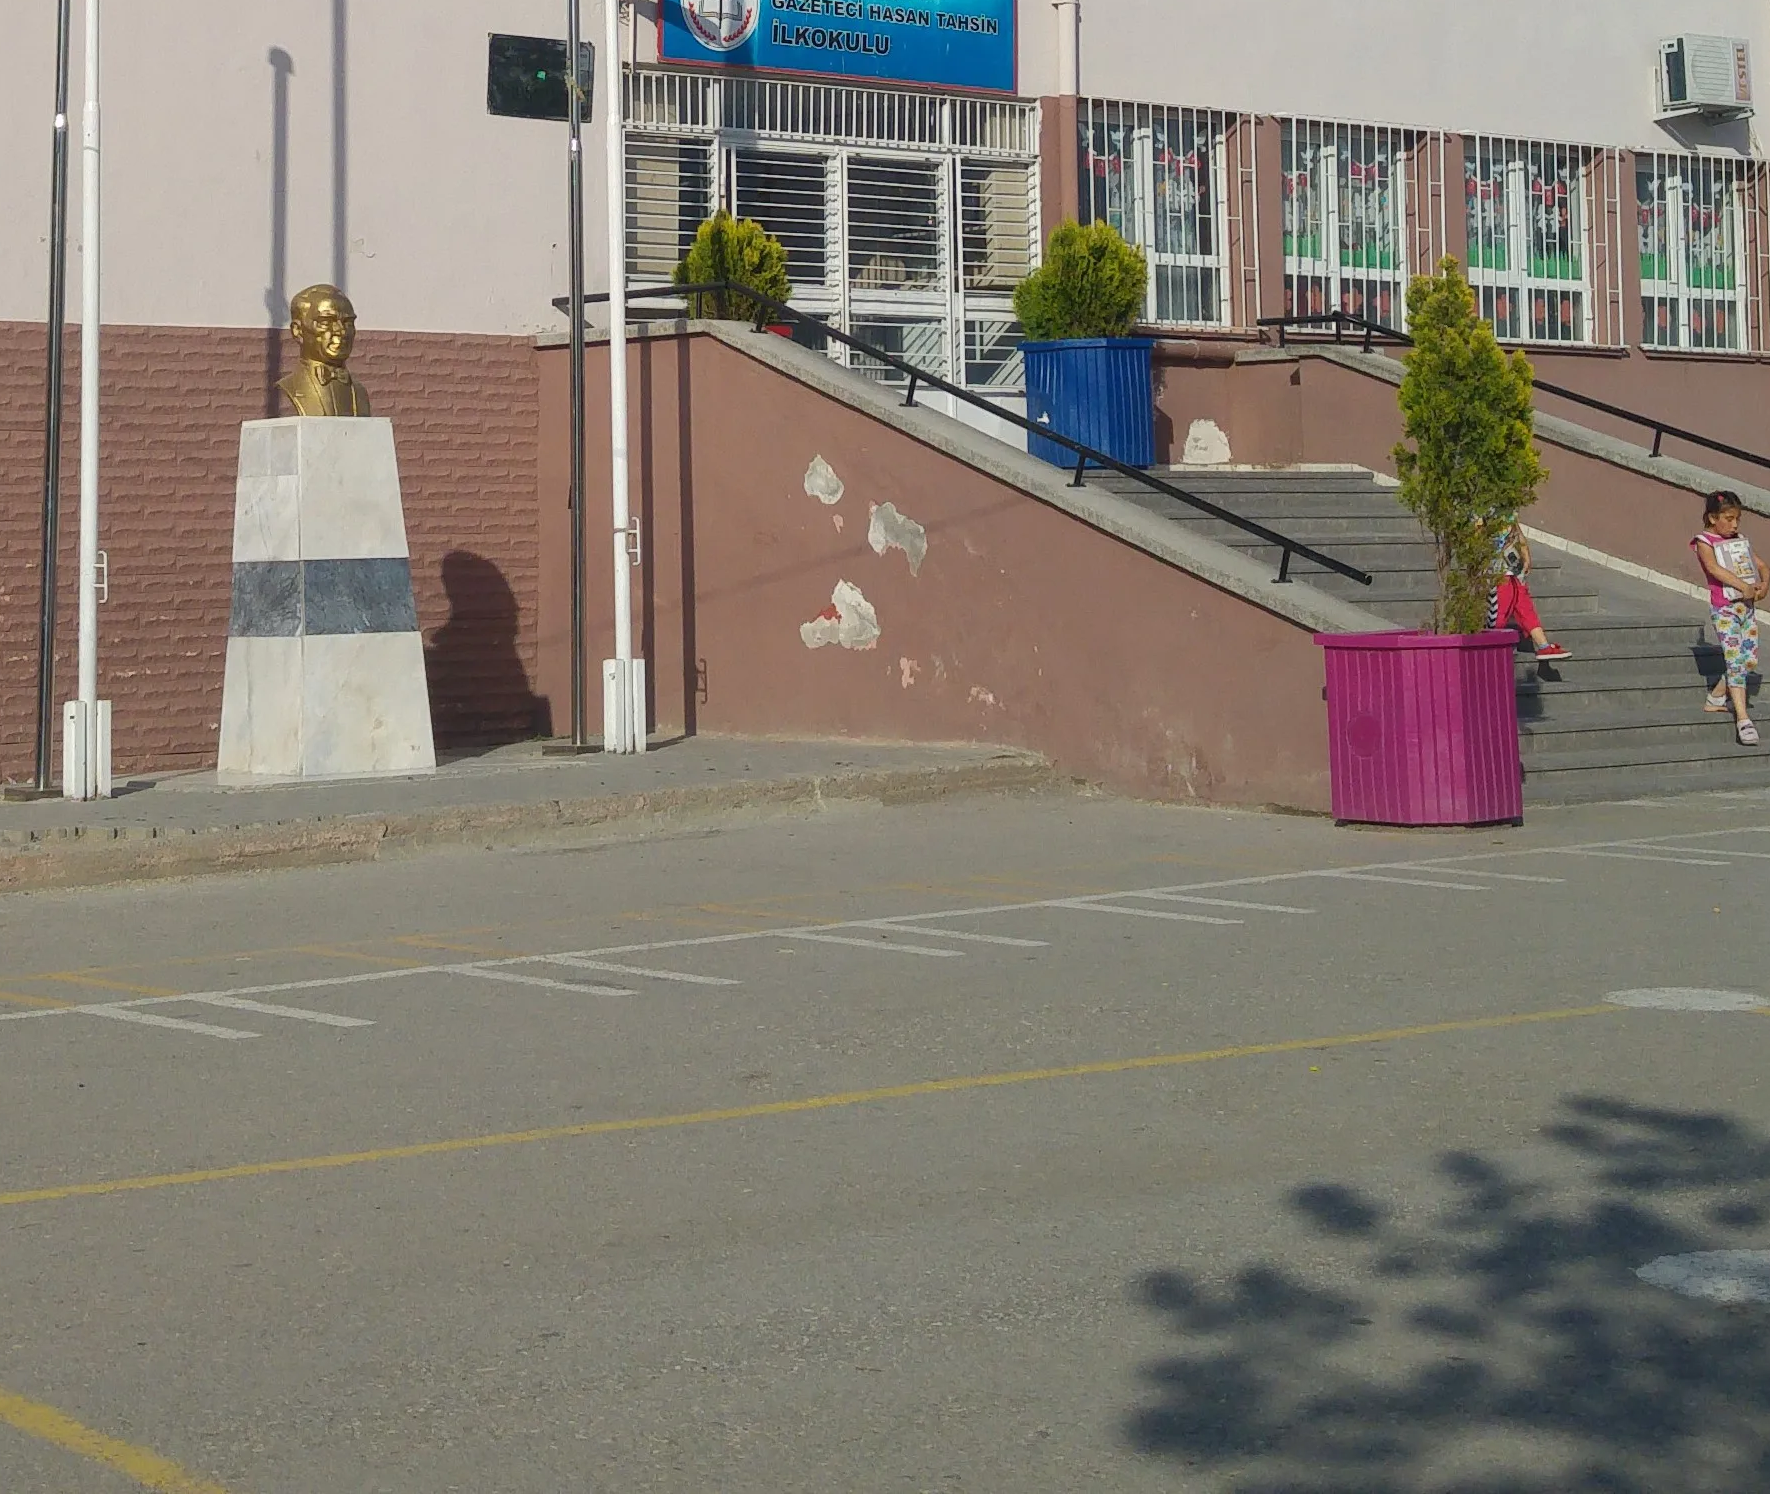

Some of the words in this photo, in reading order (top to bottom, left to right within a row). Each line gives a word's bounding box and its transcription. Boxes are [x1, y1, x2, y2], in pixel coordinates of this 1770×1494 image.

[772, 18, 891, 55] İLKOKULU
[869, 4, 930, 27] HASAN
[936, 12, 999, 35] TAHSİN
